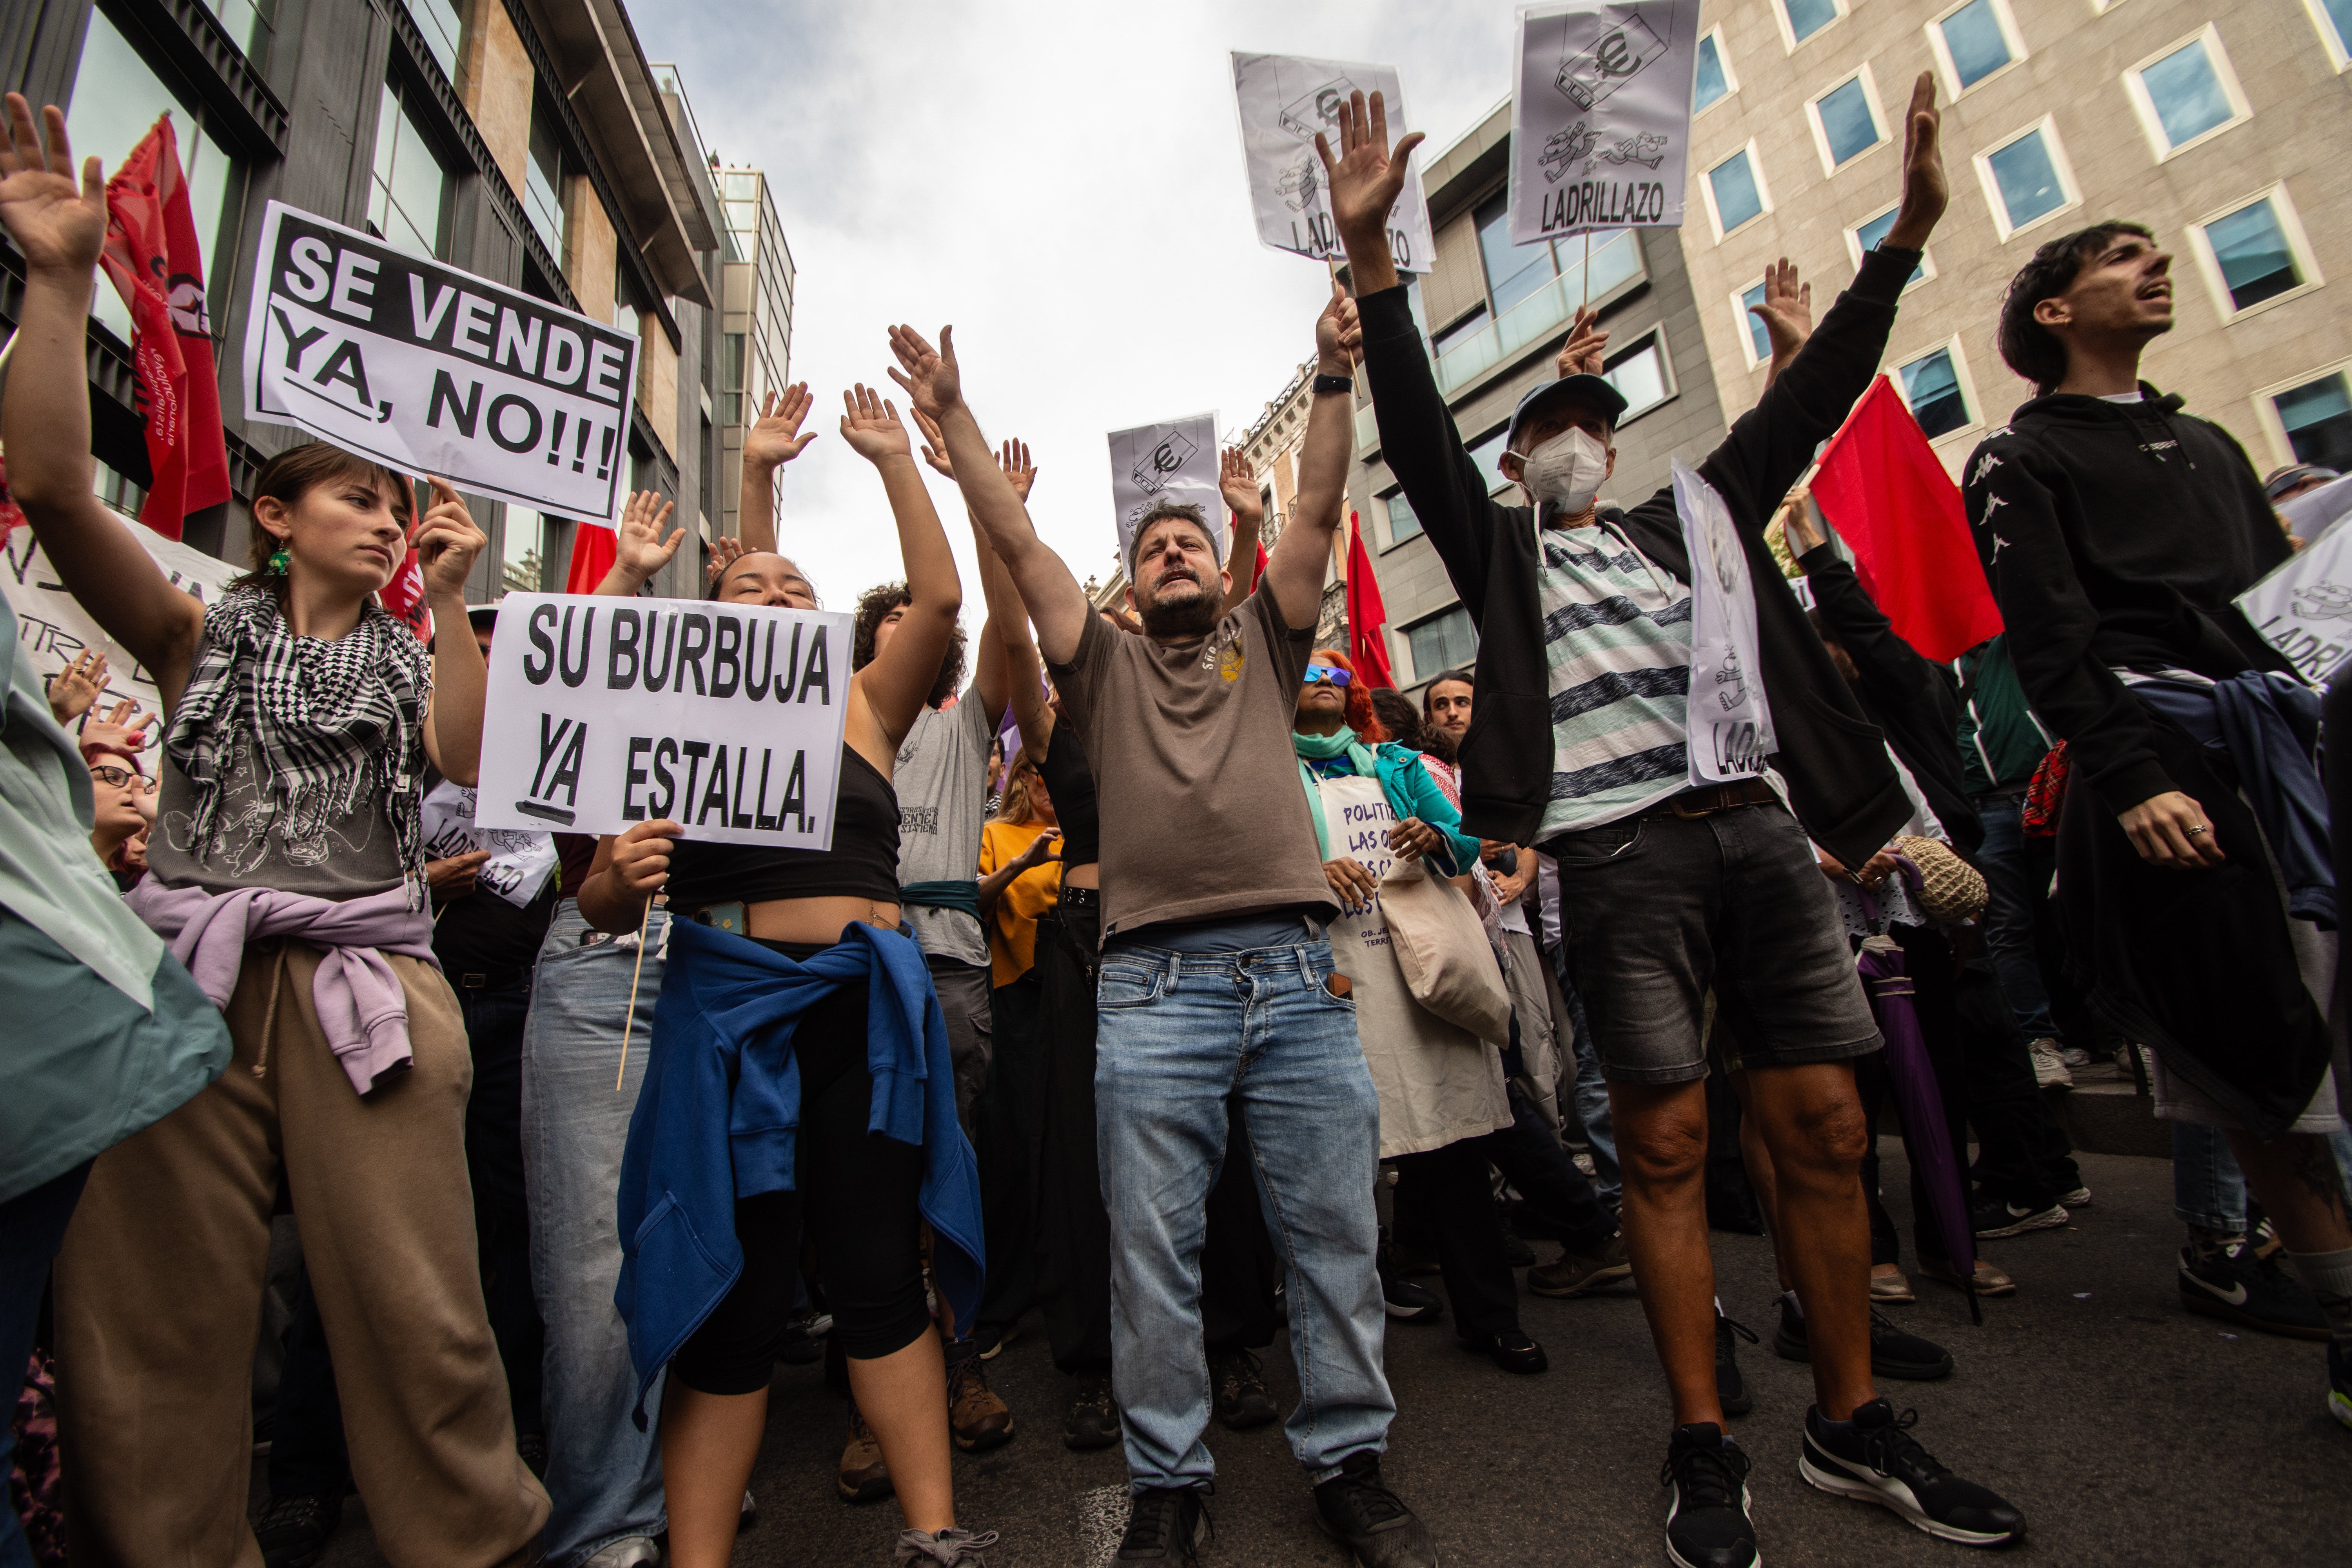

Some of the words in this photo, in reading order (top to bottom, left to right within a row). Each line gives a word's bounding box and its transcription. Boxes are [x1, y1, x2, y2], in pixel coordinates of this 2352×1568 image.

[1541, 181, 1664, 233] LADRILLAZO
[285, 237, 380, 321] SE
[409, 273, 624, 402] VENDE
[270, 304, 393, 423] YA,
[426, 369, 616, 481] NO!!!
[524, 604, 595, 688] SU
[607, 608, 830, 706] BURBUJA
[530, 713, 588, 807] YA
[622, 737, 816, 834] ESTALLA.
[901, 823, 937, 835] SISTEMA
[1348, 830, 1377, 852] LAS
